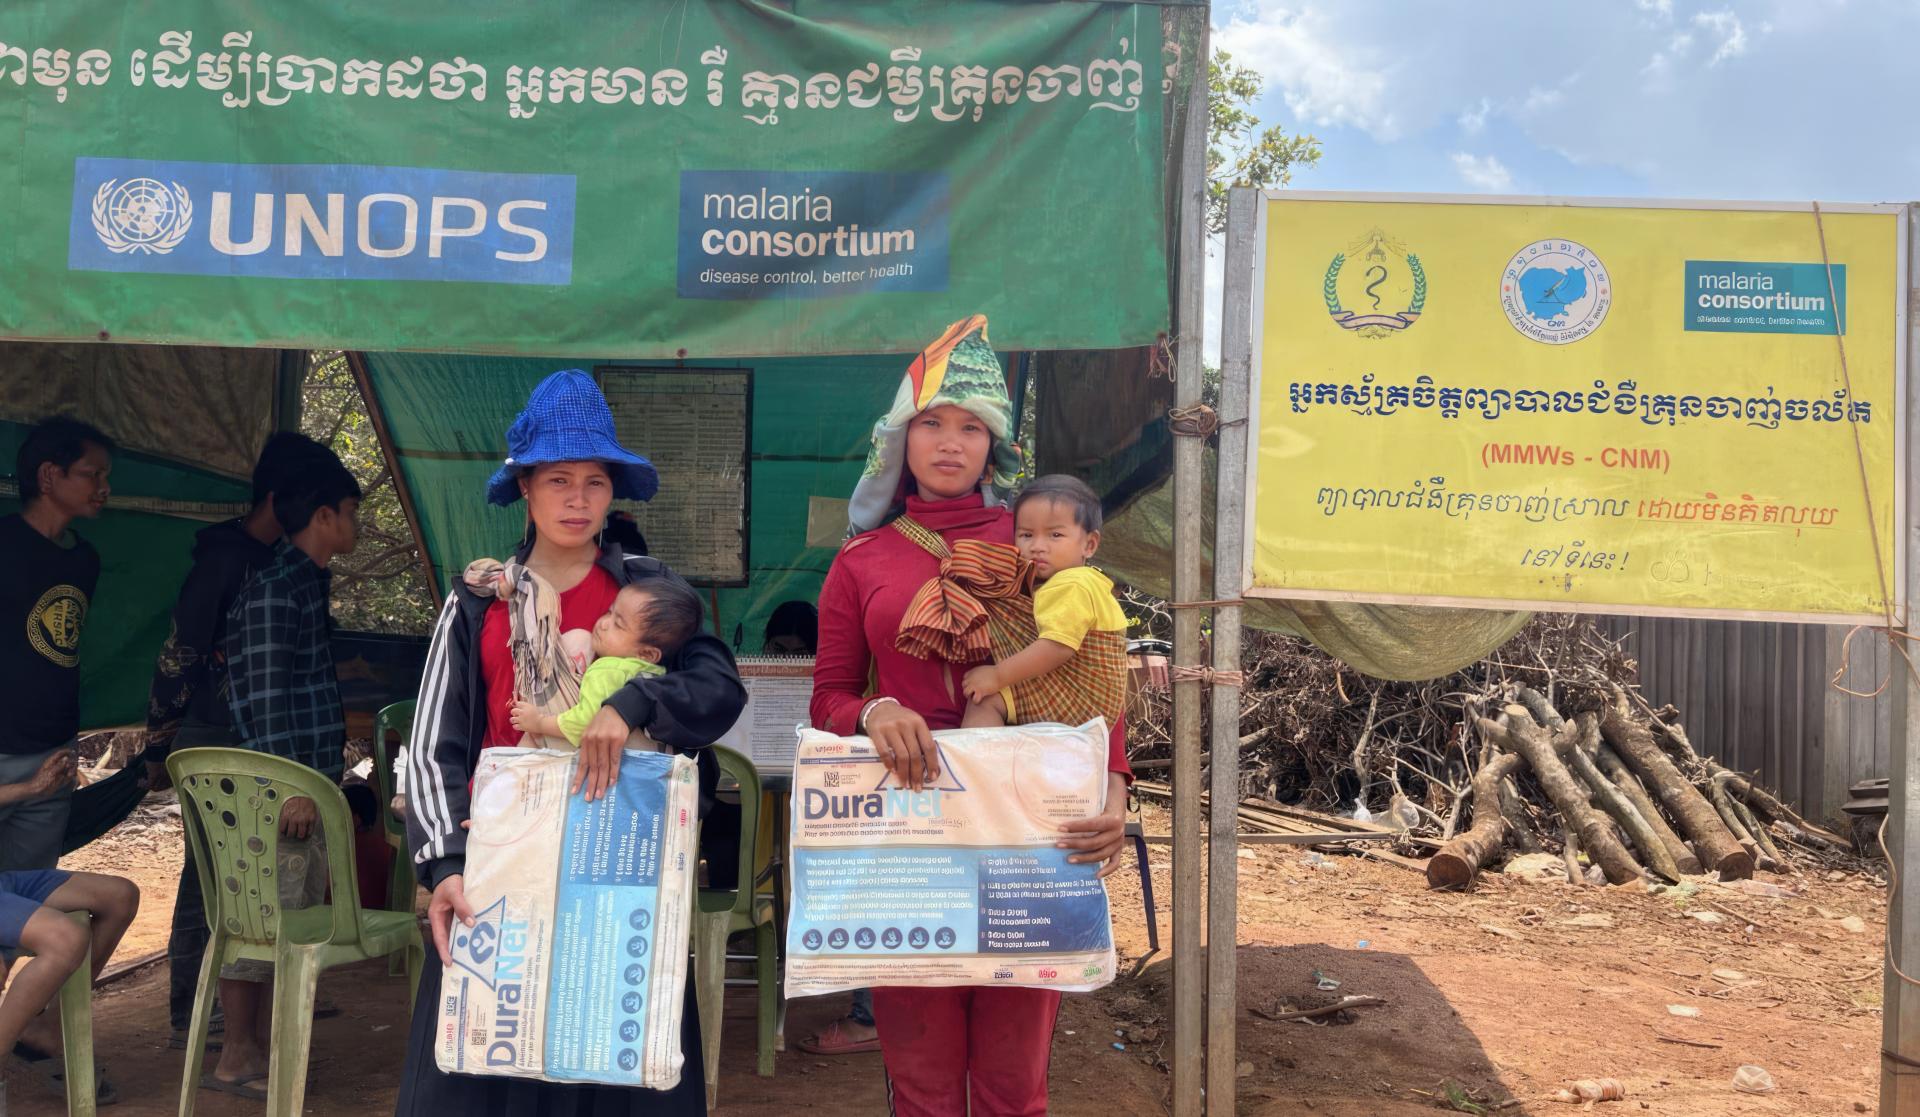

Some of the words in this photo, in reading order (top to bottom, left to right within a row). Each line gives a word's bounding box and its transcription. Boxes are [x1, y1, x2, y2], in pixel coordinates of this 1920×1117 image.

[0, 42, 111, 104] ាមុន
[703, 187, 832, 222] malaria
[209, 191, 548, 262] UNOPS
[701, 224, 915, 257] consortium
[700, 269, 759, 284] disease
[763, 270, 817, 285] control,
[822, 270, 866, 284] better
[1698, 271, 1773, 291] malaria
[1698, 291, 1825, 311] consortium
[1481, 442, 1575, 468] (MMWs
[1600, 447, 1670, 474] CNM)
[486, 919, 528, 1067] DuraNet
